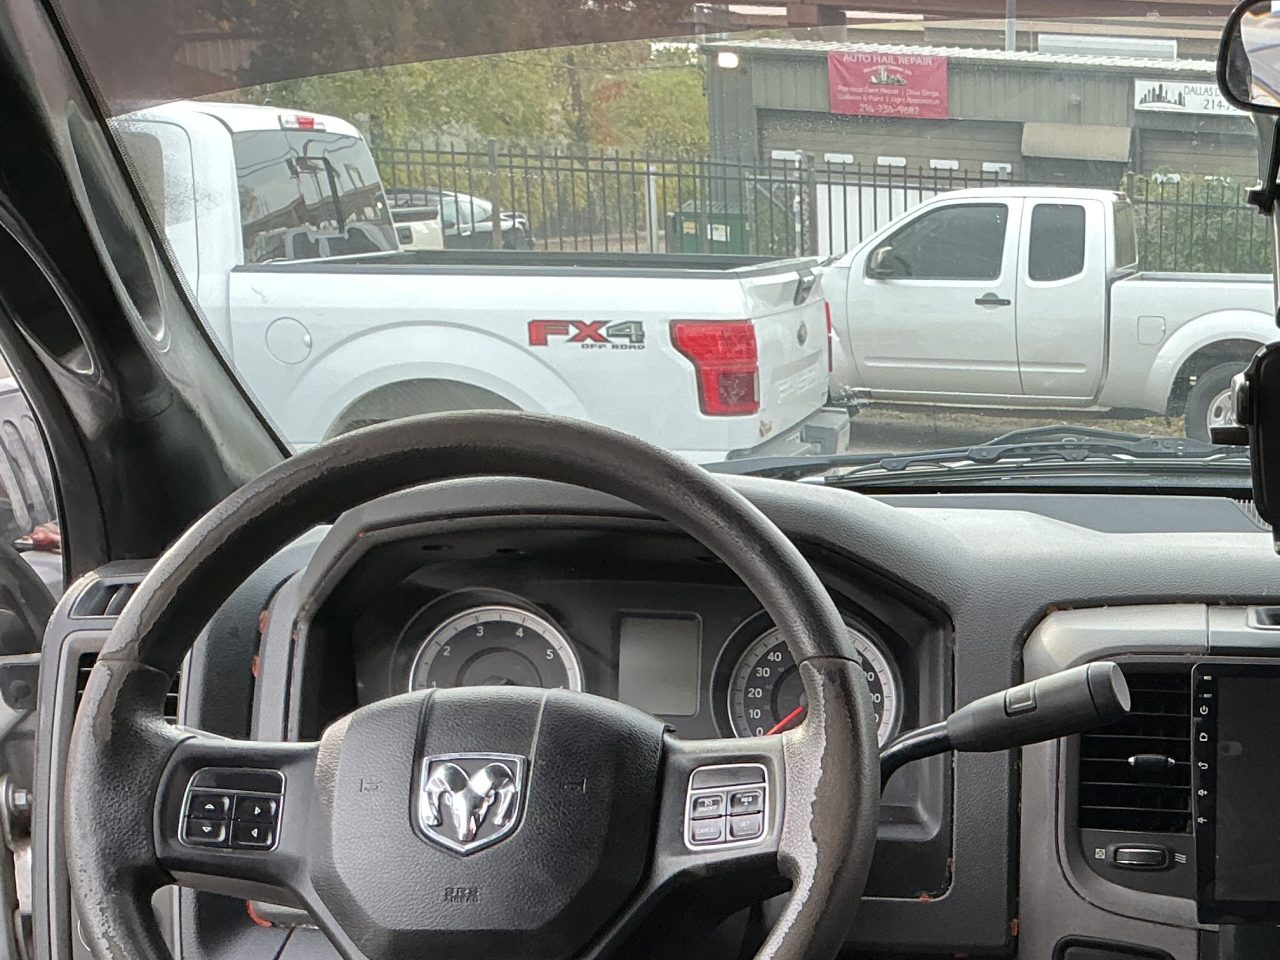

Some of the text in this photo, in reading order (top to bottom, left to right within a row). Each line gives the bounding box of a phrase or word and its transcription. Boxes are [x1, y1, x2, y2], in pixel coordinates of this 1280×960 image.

[843, 54, 933, 66] AUTO HAIL REPAIR
[1183, 86, 1214, 97] DALLAS
[528, 319, 645, 347] FX4
[475, 626, 484, 637] 3
[515, 627, 524, 638] 4
[443, 646, 451, 656] 2
[546, 649, 554, 659] 5
[767, 652, 782, 662] 40
[756, 667, 770, 678] 30
[747, 687, 763, 698] 20
[749, 708, 761, 719] 10
[756, 727, 764, 737] 0
